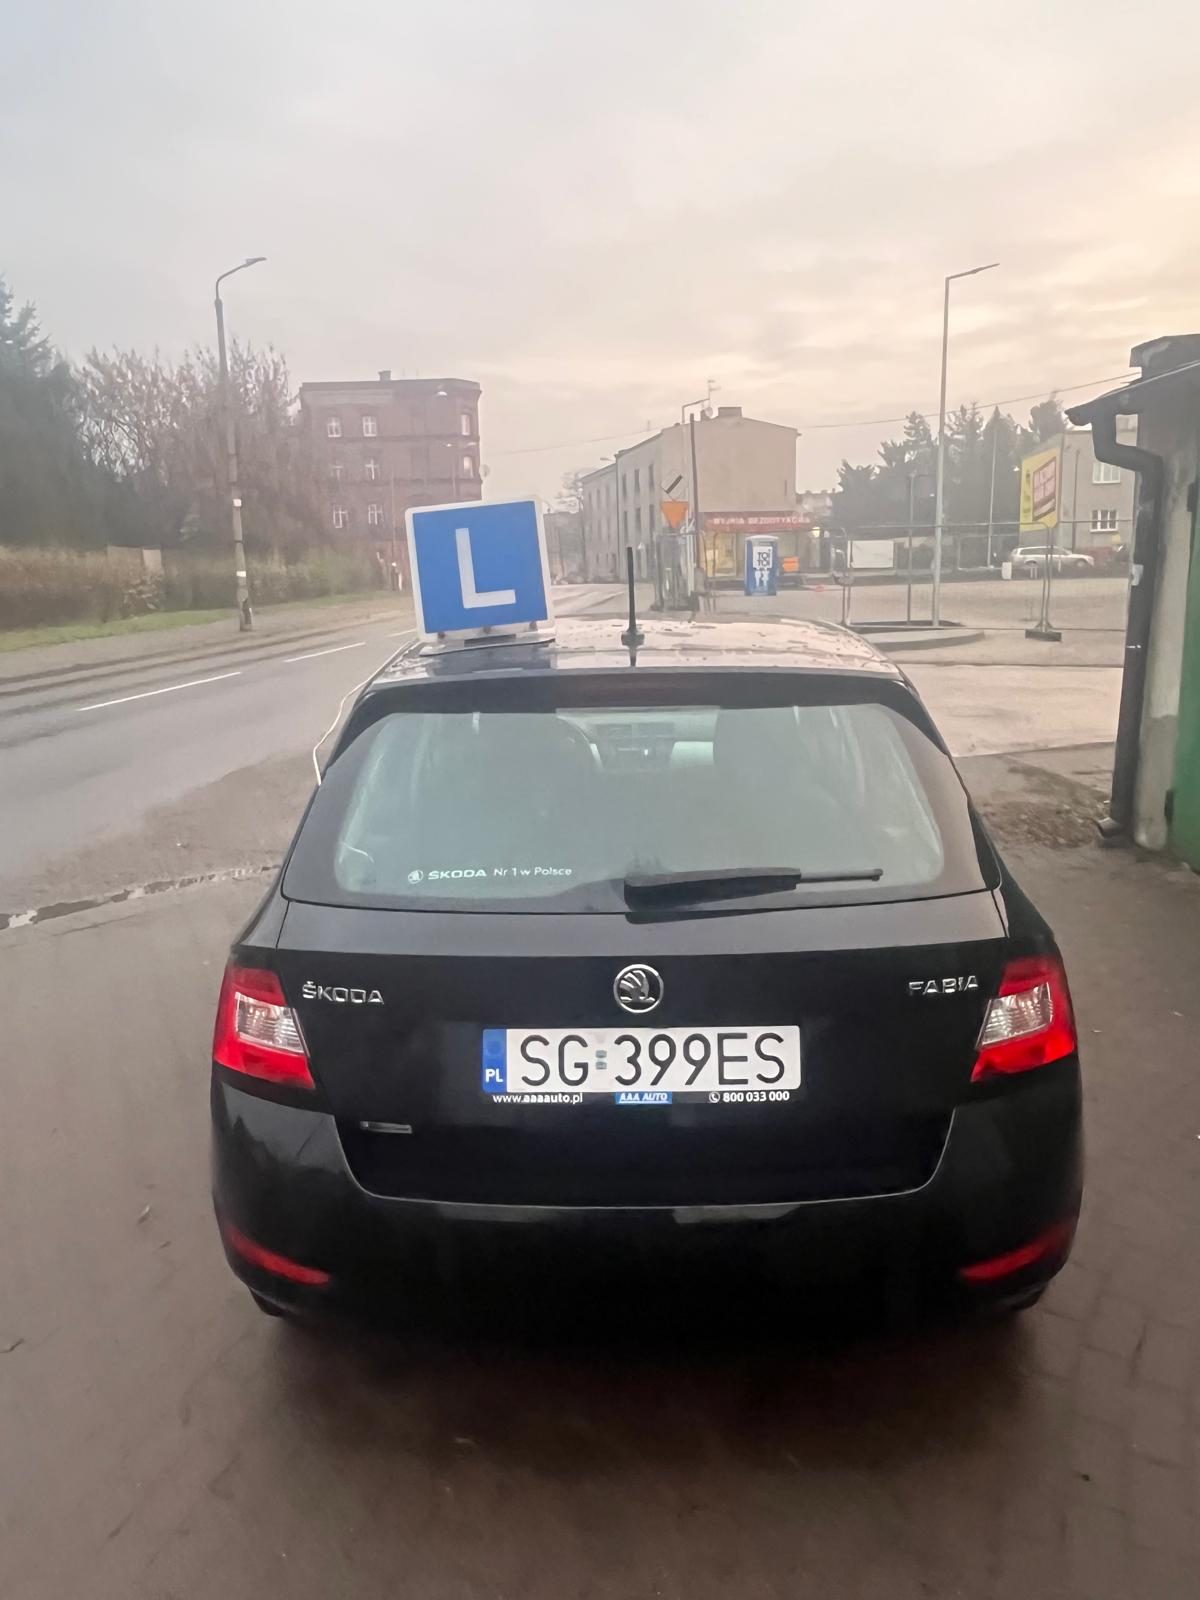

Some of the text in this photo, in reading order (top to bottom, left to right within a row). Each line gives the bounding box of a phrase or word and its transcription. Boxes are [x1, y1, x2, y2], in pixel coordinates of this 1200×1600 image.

[455, 527, 516, 609] L
[493, 868, 508, 876] Nr
[511, 867, 517, 876] 1
[534, 866, 572, 876] Polsce
[302, 980, 384, 1004] ŠKODA
[908, 975, 978, 996] FABIA
[520, 1032, 785, 1086] SG 399ES
[485, 1069, 503, 1082] PL
[493, 1093, 583, 1104] www.aaaauto.pl
[619, 1092, 668, 1103] AAA AUTO
[723, 1091, 790, 1102] 800 033 000
